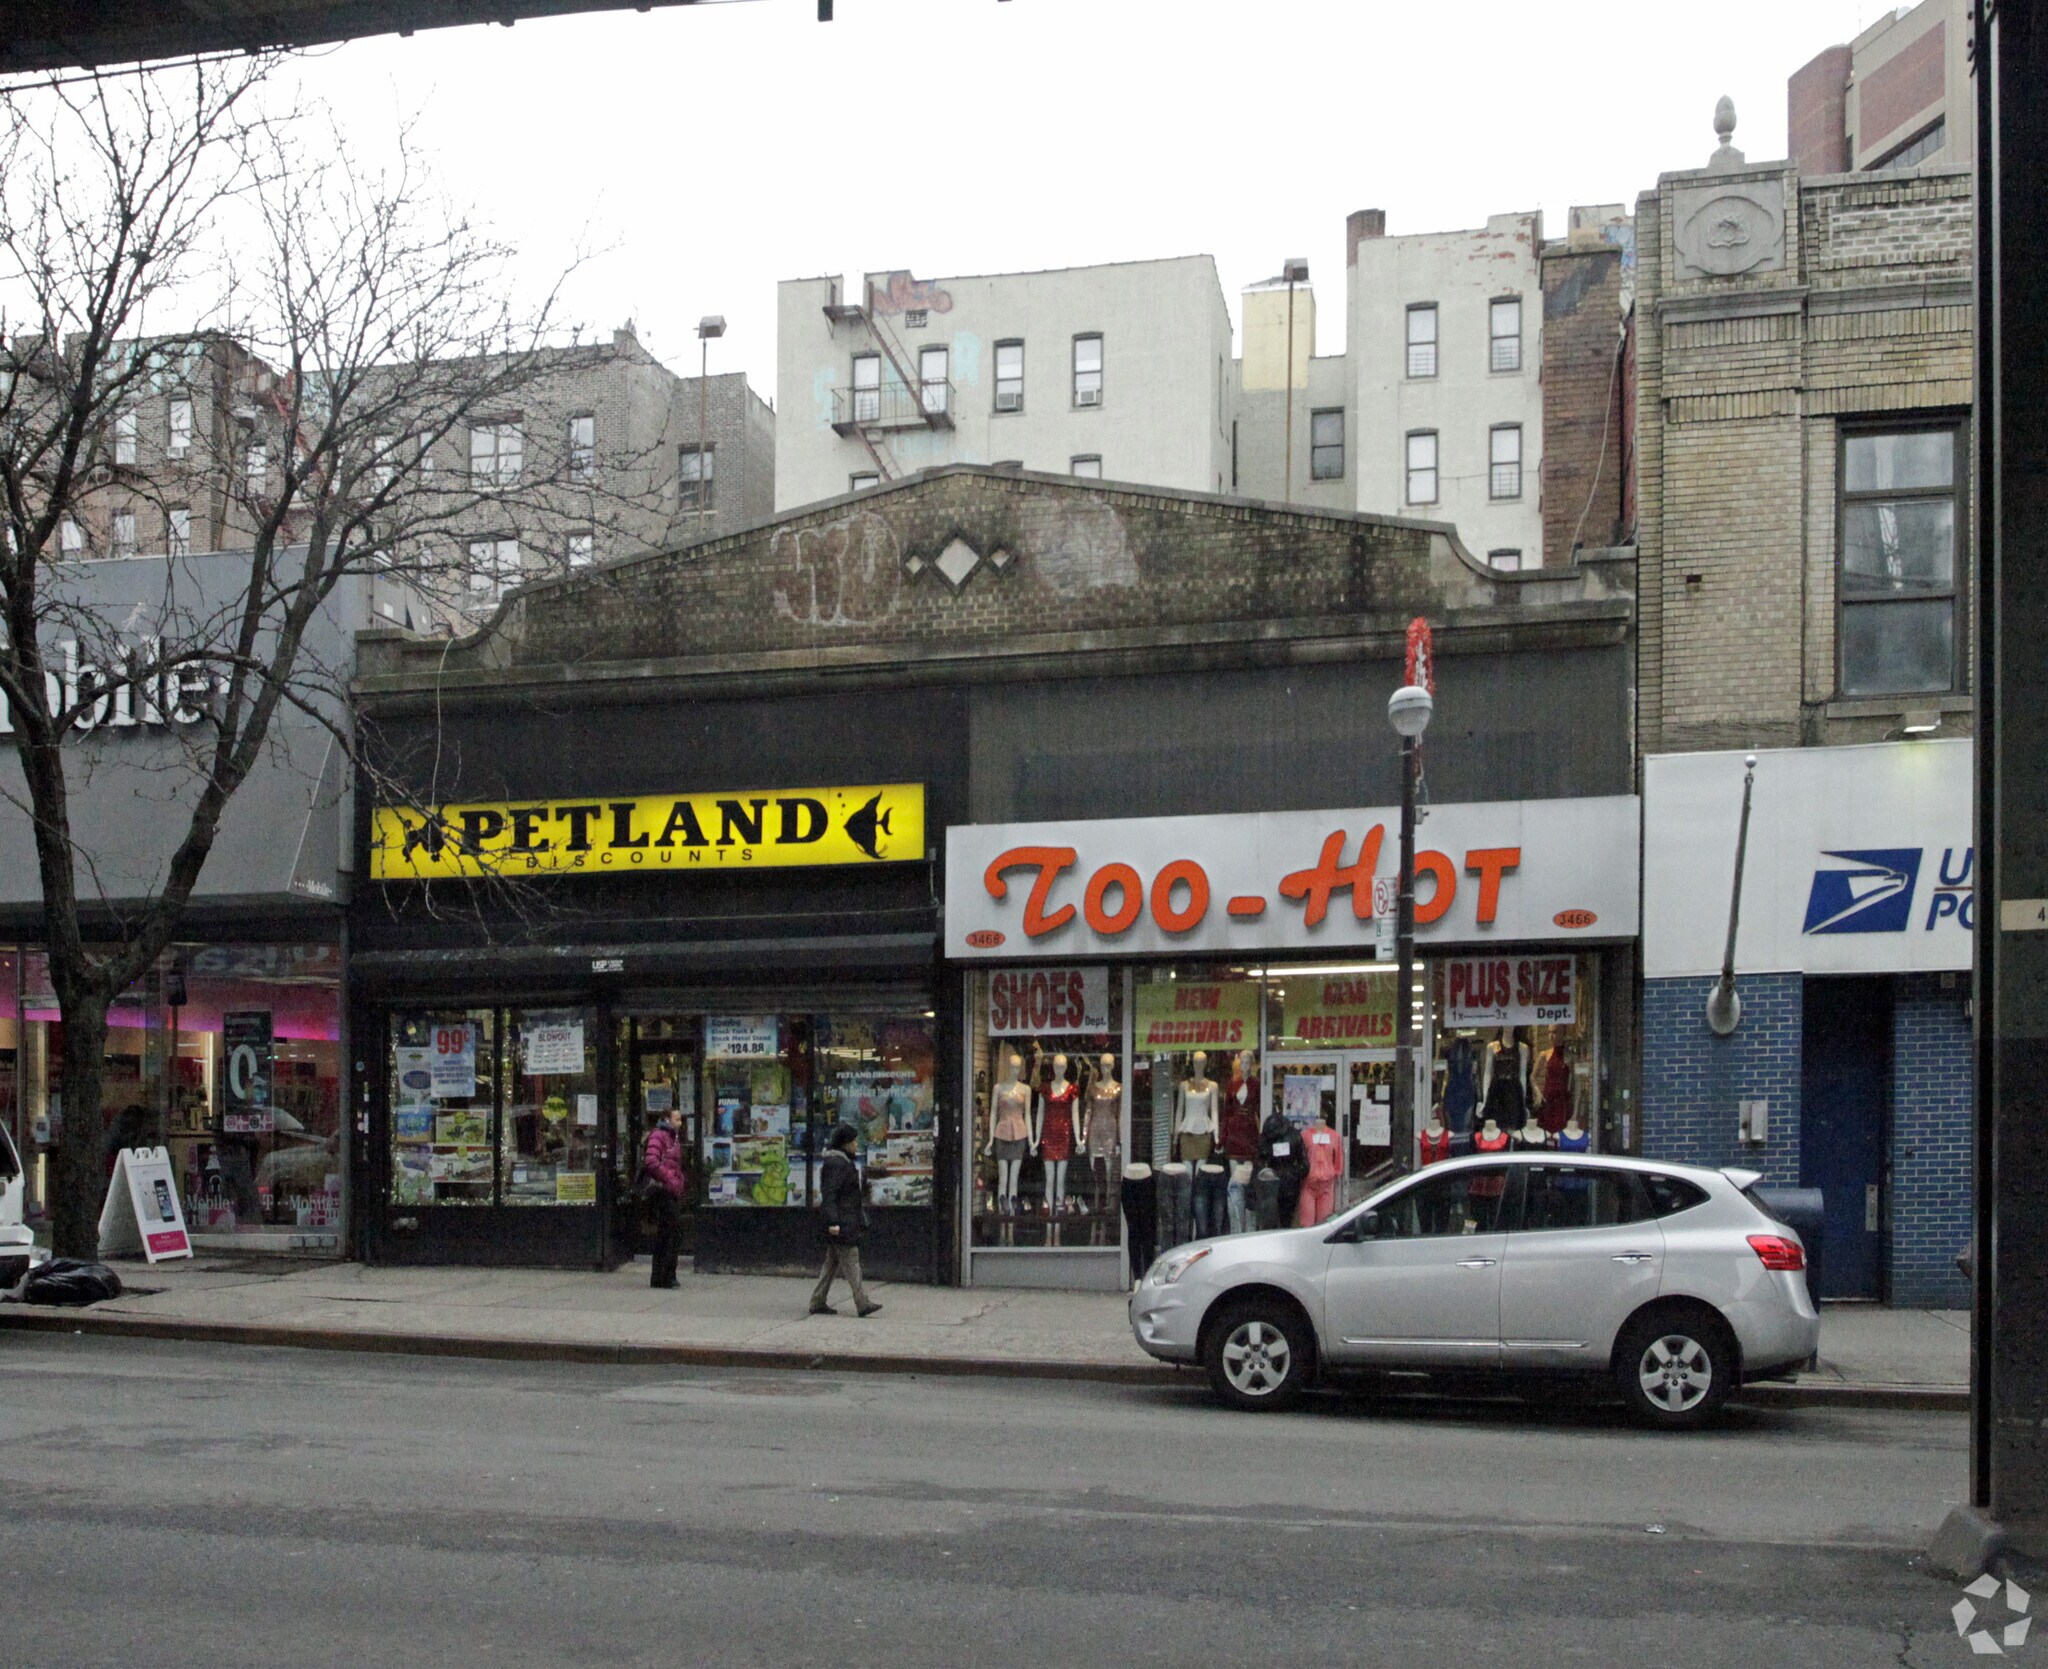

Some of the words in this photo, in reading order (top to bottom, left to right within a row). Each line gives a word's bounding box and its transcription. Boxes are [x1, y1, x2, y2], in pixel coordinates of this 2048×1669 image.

[459, 798, 829, 855] PETLAND
[526, 848, 754, 869] DISCOUNTS
[1559, 913, 1591, 926] 3466
[971, 934, 1000, 945] 3466
[1450, 960, 1511, 1009] PLUS
[1517, 959, 1571, 1007] SIZE
[991, 970, 1085, 1030] SHOES
[1085, 1014, 1107, 1028] Dept.
[1174, 987, 1222, 1011] NEW
[1536, 1007, 1572, 1021] Dept.
[1147, 1019, 1245, 1044] ARRIVALS
[1295, 1012, 1393, 1039] ARRIVALS
[538, 1031, 571, 1043] BLOWOUT
[835, 1071, 872, 1079] PETLAND
[873, 1070, 917, 1078] DISCOUNTS
